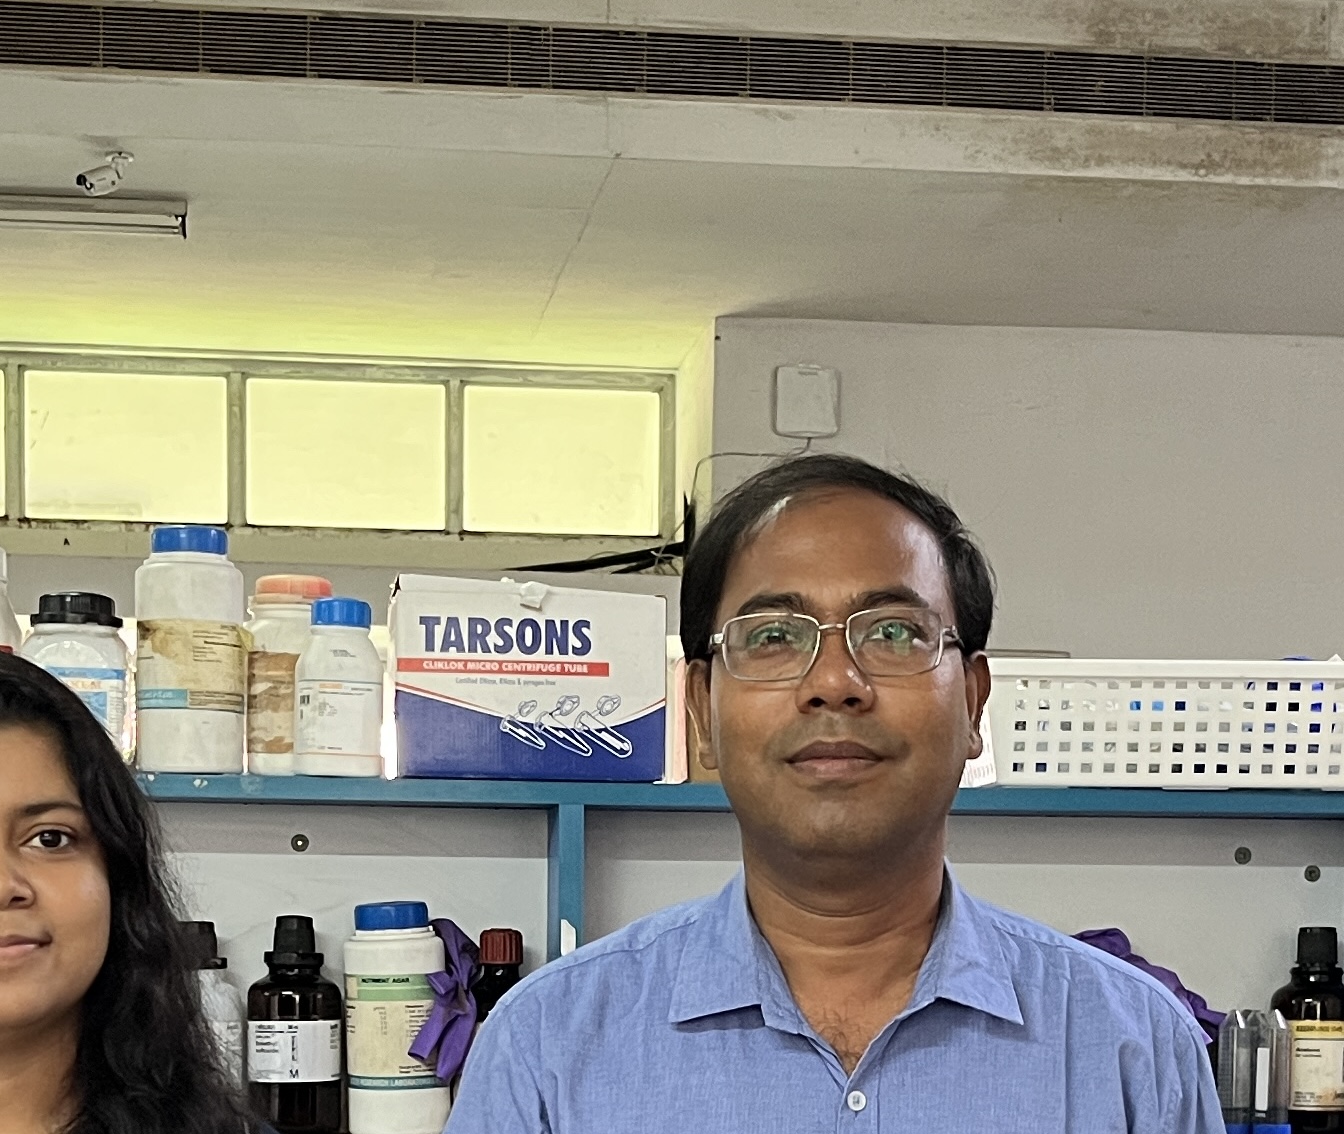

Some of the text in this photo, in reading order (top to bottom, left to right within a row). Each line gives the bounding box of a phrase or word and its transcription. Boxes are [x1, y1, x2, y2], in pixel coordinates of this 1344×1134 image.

[419, 616, 592, 656] TARSONS
[423, 661, 588, 673] CLIKLOK MICRO CENTRIFUGE TUBE
